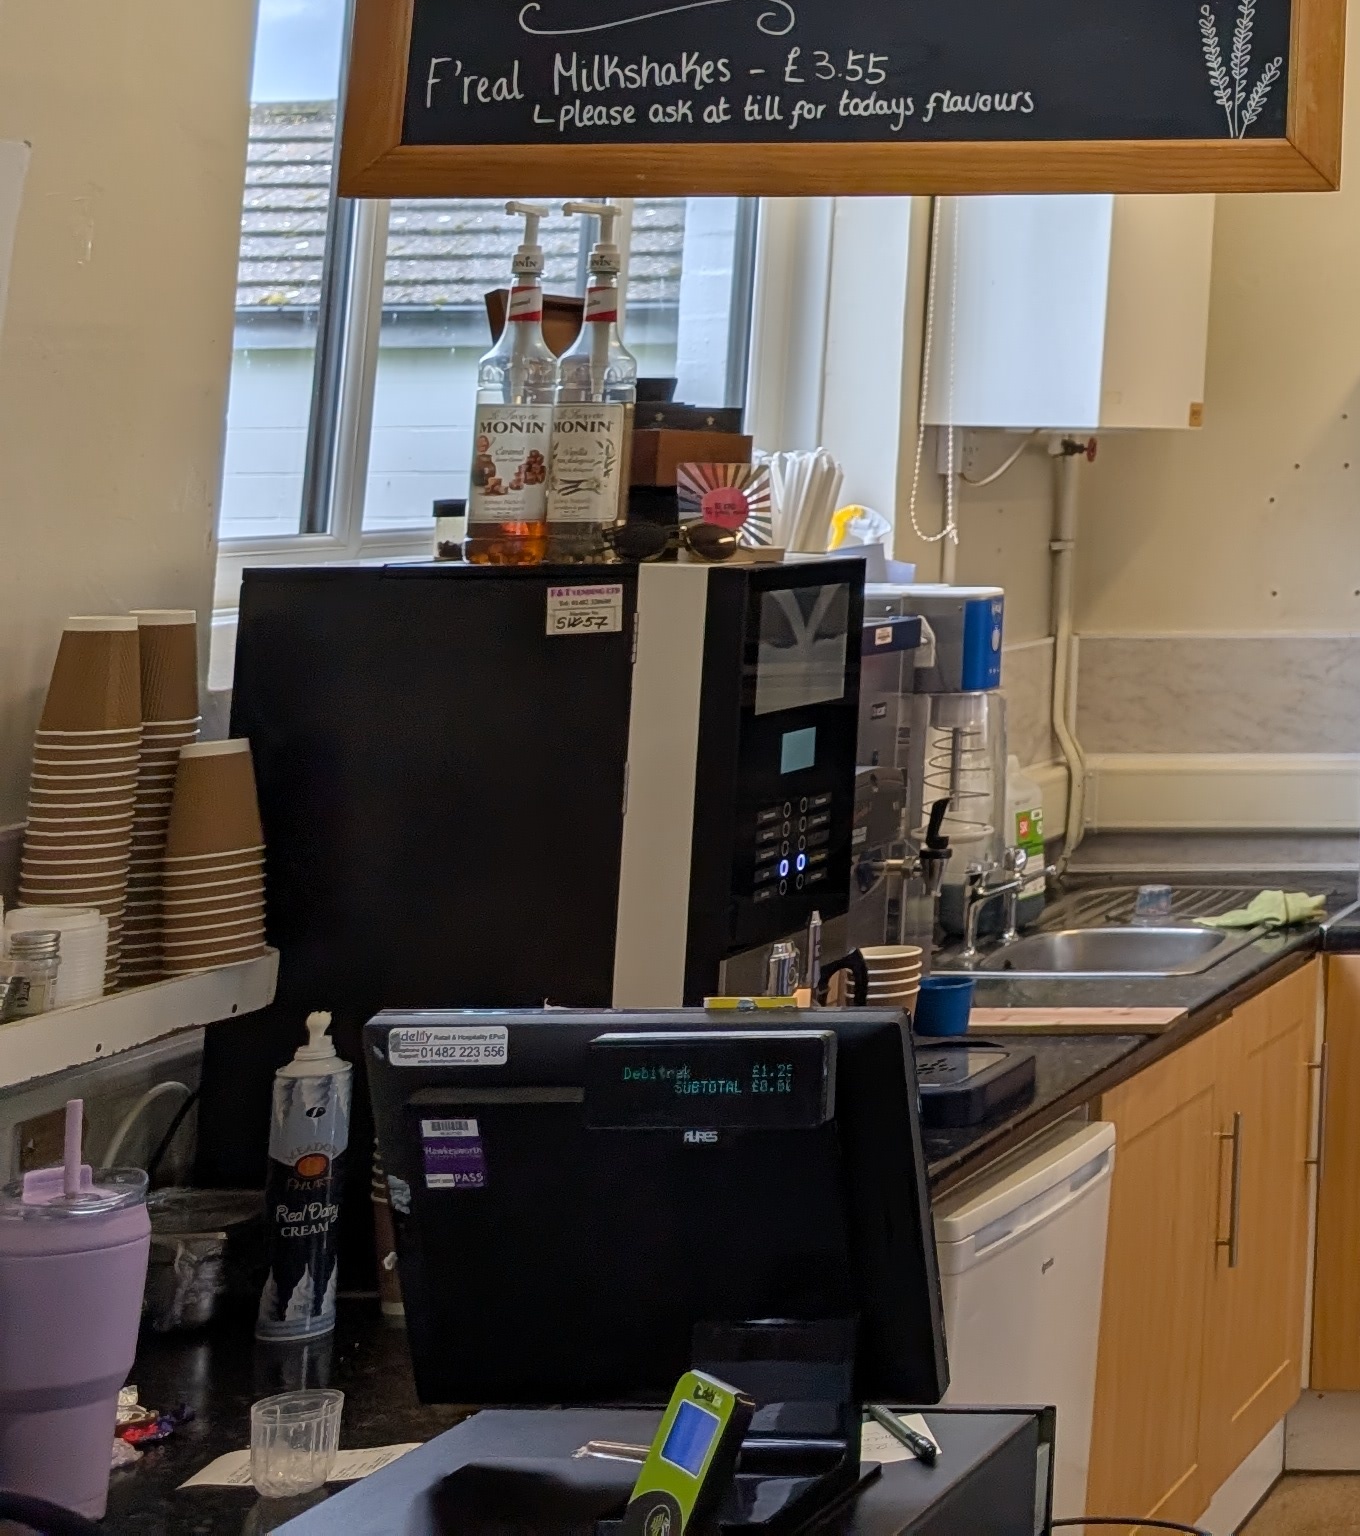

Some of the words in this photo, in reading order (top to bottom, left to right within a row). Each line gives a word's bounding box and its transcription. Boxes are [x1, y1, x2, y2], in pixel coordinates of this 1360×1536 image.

[553, 52, 730, 96] Milkshakes
[784, 46, 888, 84] £3.55
[559, 100, 635, 131] please
[649, 98, 691, 124] ask
[703, 97, 730, 123] at
[744, 96, 782, 121] till
[789, 98, 826, 128] for
[839, 92, 914, 130] todays
[923, 90, 1034, 121] flavours
[480, 421, 545, 434] MONIN
[420, 1044, 457, 1058] 01482
[459, 1044, 482, 1057] 223
[484, 1043, 505, 1057] 556
[280, 1222, 331, 1238] CREAM
